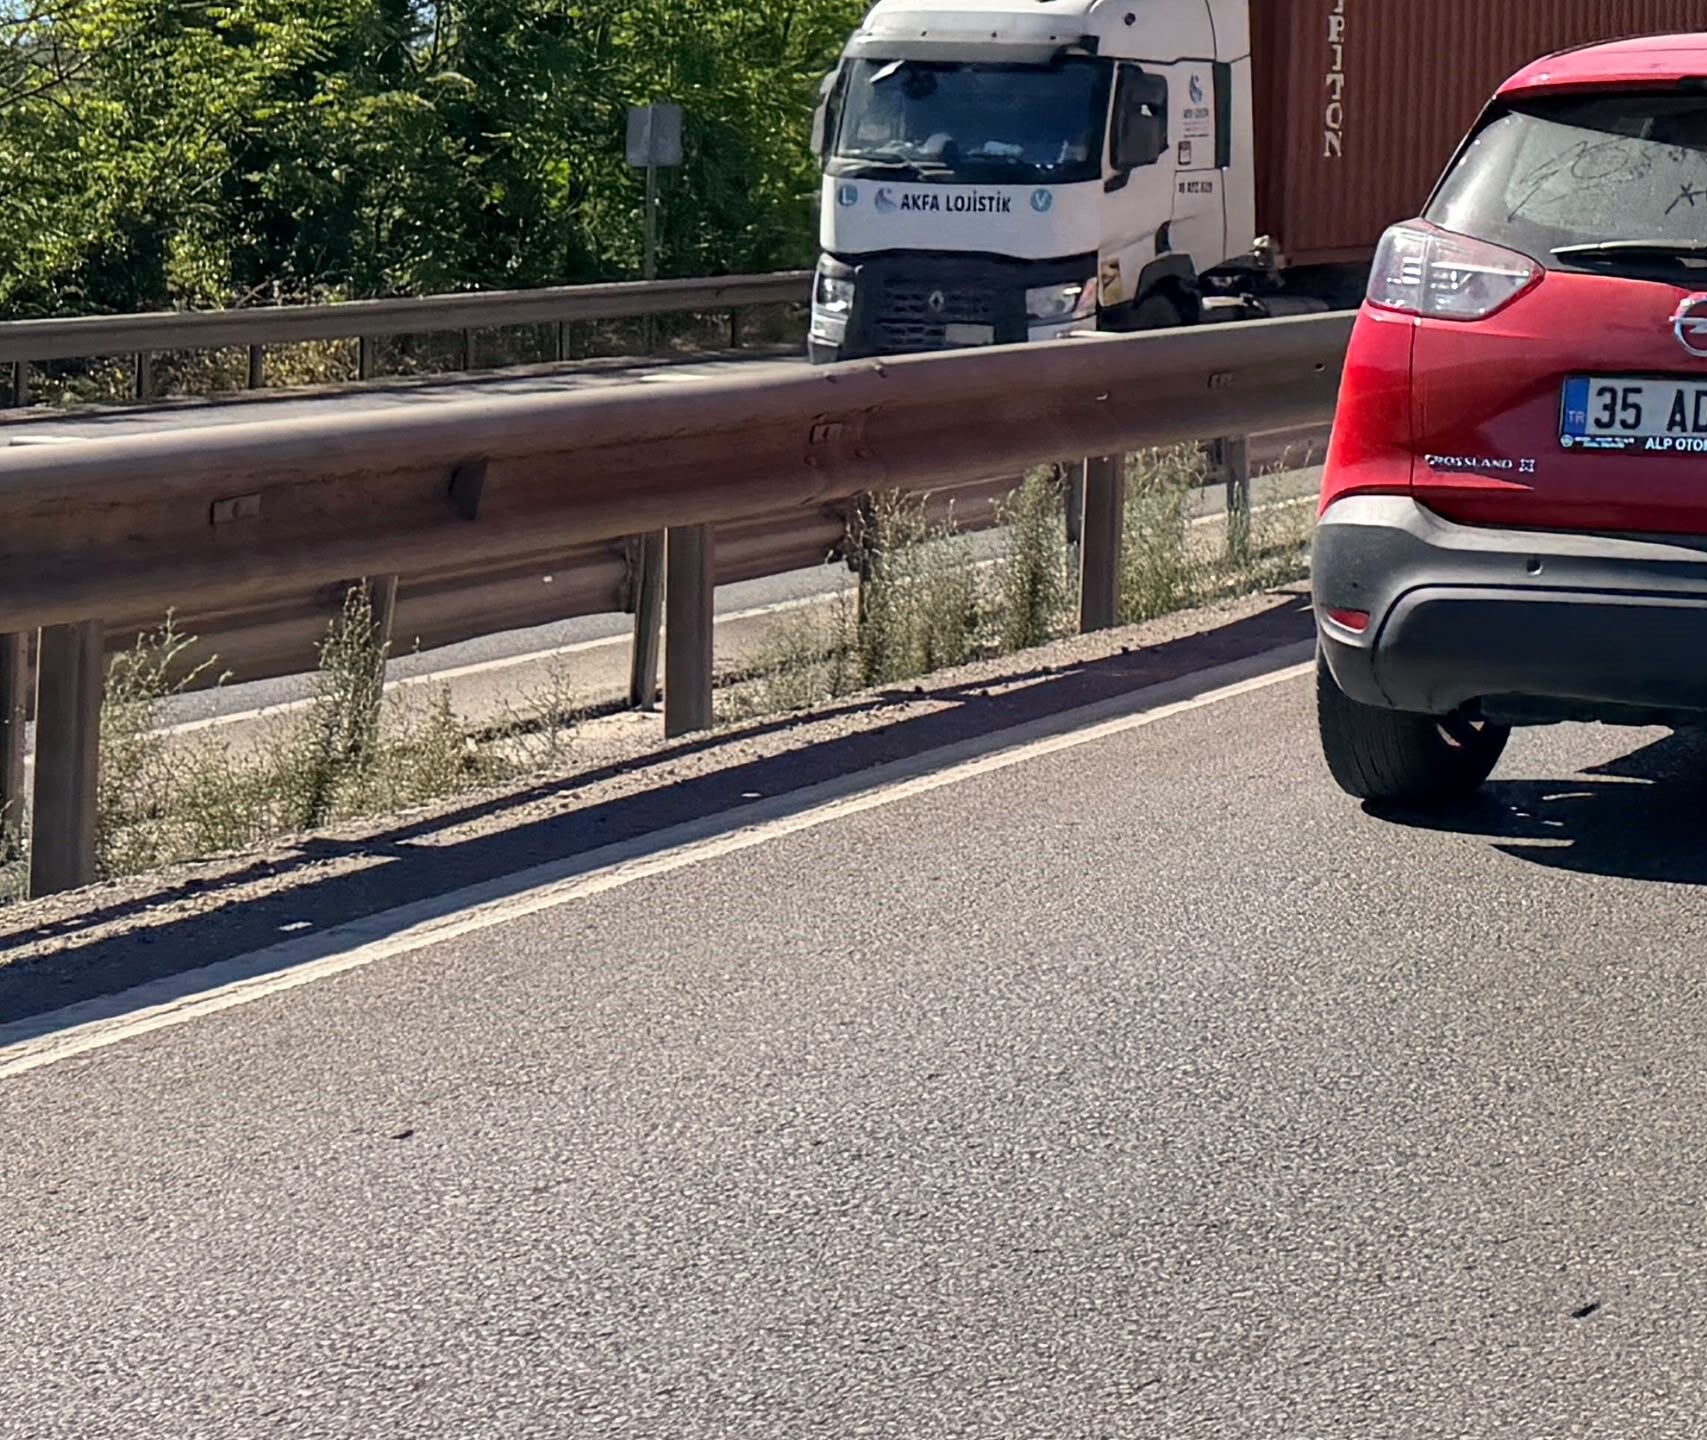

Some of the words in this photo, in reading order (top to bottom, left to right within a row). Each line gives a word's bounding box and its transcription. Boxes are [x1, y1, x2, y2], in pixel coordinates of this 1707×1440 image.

[901, 193, 940, 211] AKFA
[946, 190, 1011, 213] LOJİSTİK
[1568, 410, 1586, 424] TR
[1593, 386, 1644, 430] 35
[1644, 436, 1673, 451] ALP
